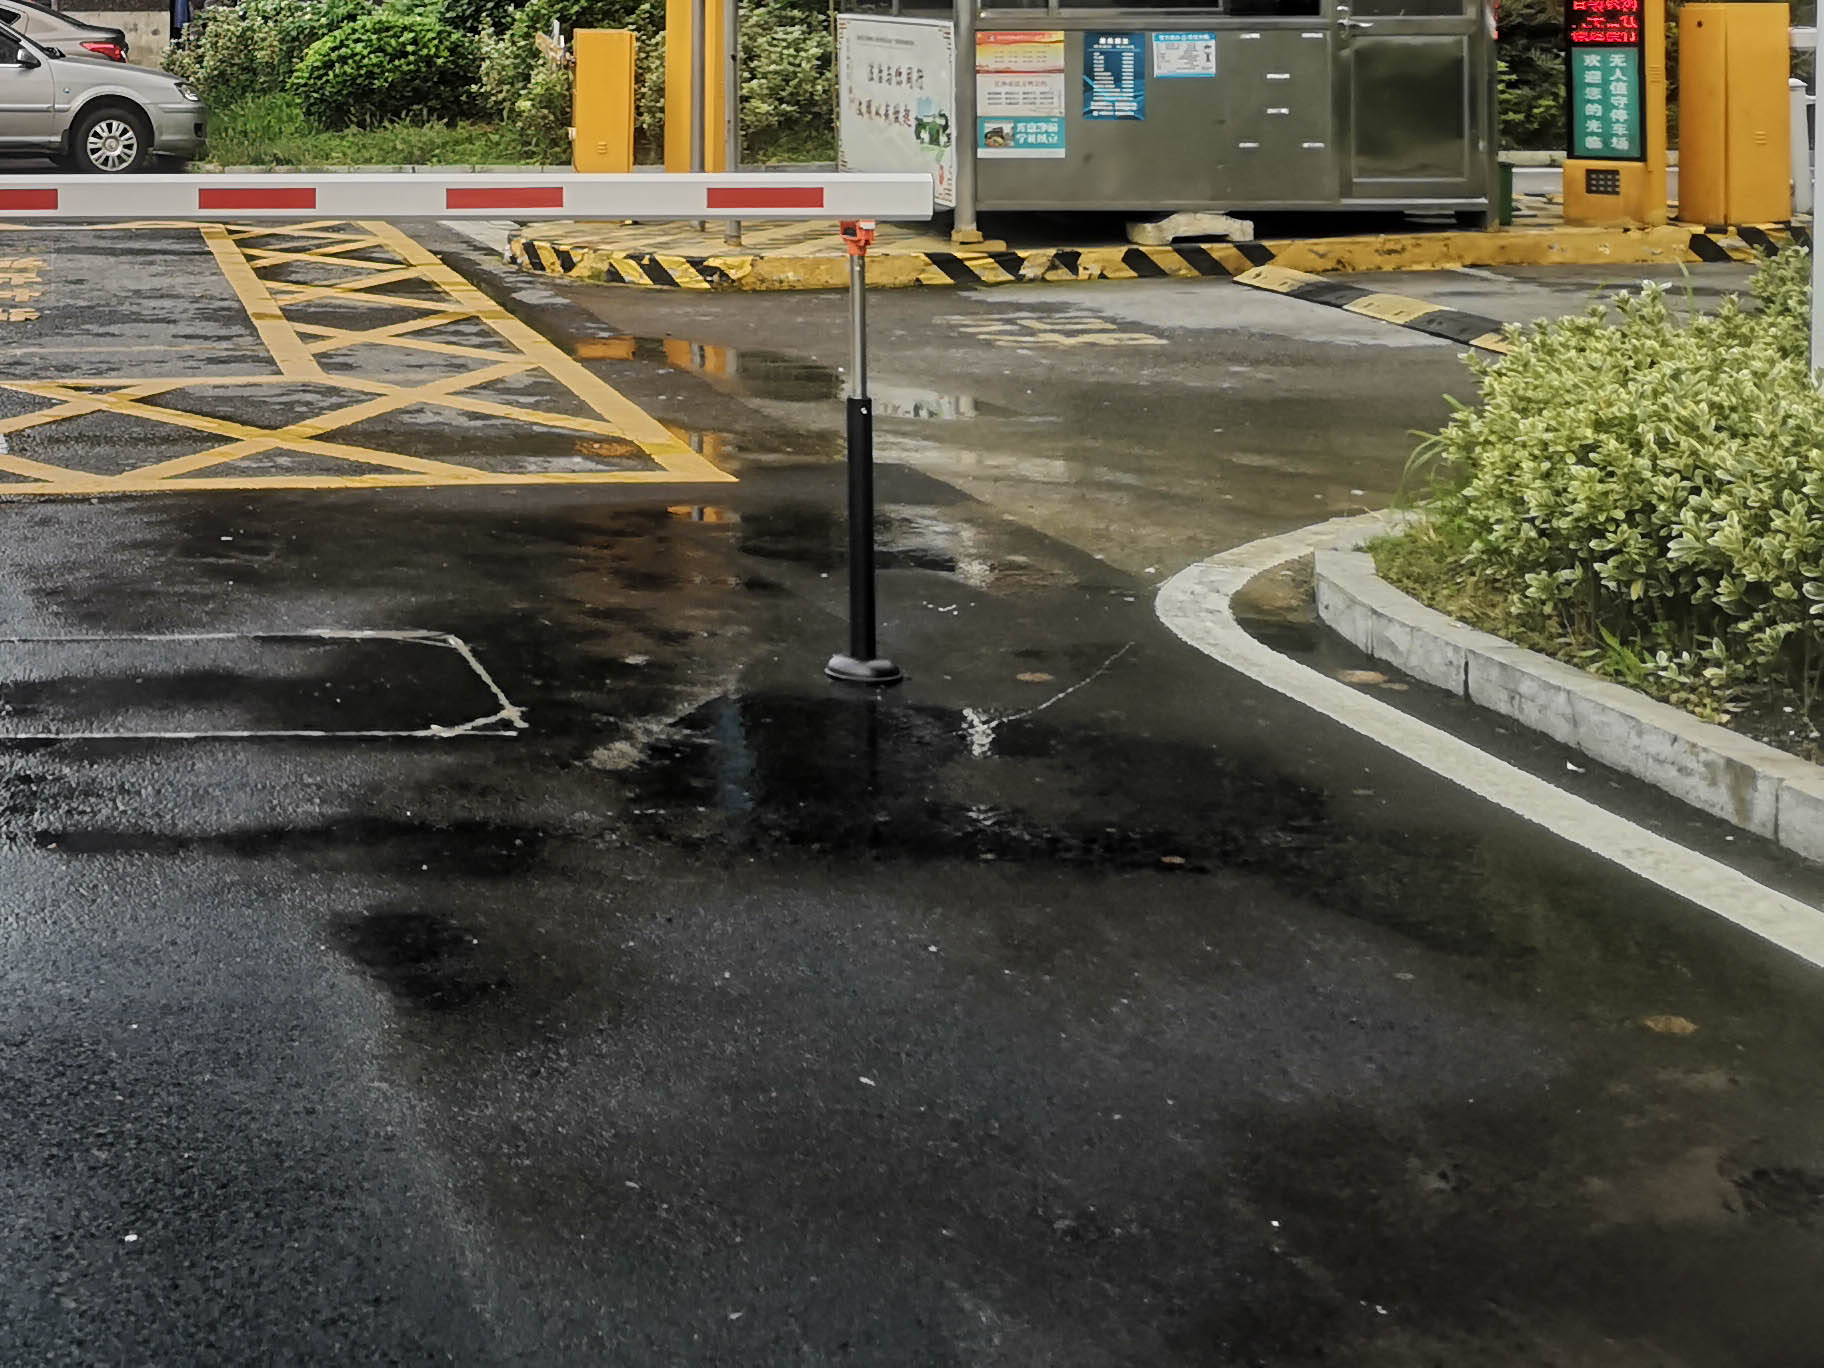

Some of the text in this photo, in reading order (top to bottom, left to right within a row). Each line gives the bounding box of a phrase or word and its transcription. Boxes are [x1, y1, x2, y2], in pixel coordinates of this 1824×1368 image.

[1583, 53, 1604, 150] 欢迎您的光临
[1609, 53, 1630, 150] 无人值守停车场
